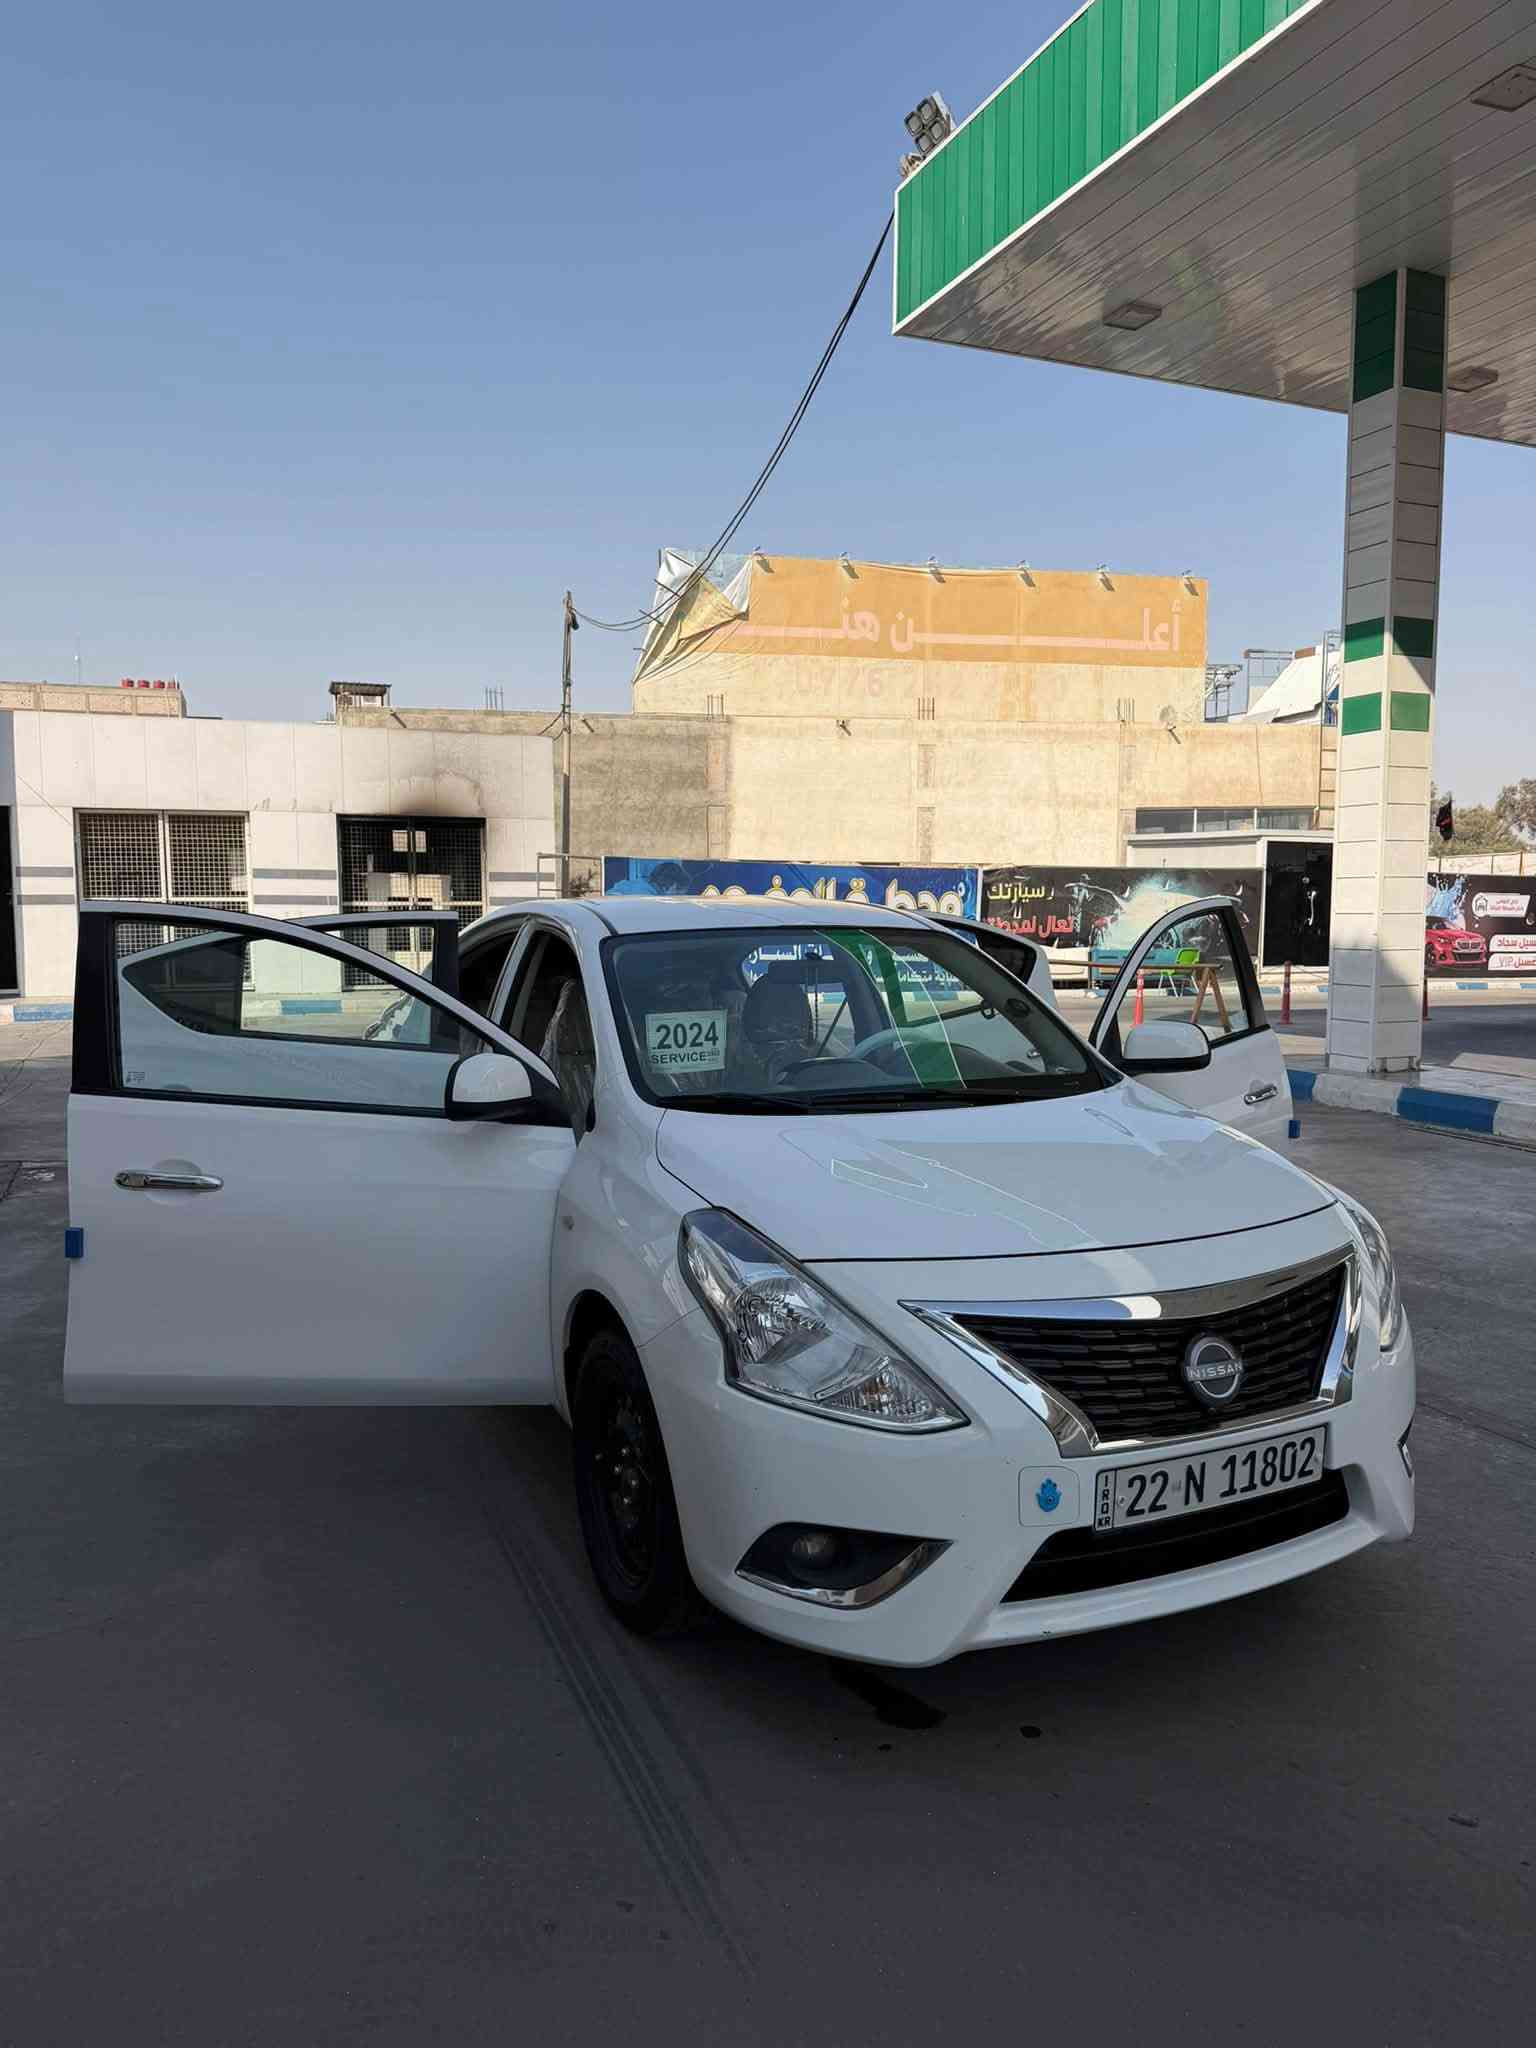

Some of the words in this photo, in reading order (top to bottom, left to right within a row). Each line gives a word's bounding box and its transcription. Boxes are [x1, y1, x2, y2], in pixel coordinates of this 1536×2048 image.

[987, 881, 1046, 903] سيارتك
[655, 1021, 719, 1050] 2024
[650, 1051, 707, 1065] SERVICE
[1187, 1362, 1243, 1379] NISSAN
[1126, 1470, 1169, 1517] 22
[1184, 1461, 1206, 1506] N
[1219, 1436, 1316, 1498] 11802
[1096, 1516, 1111, 1528] KR
